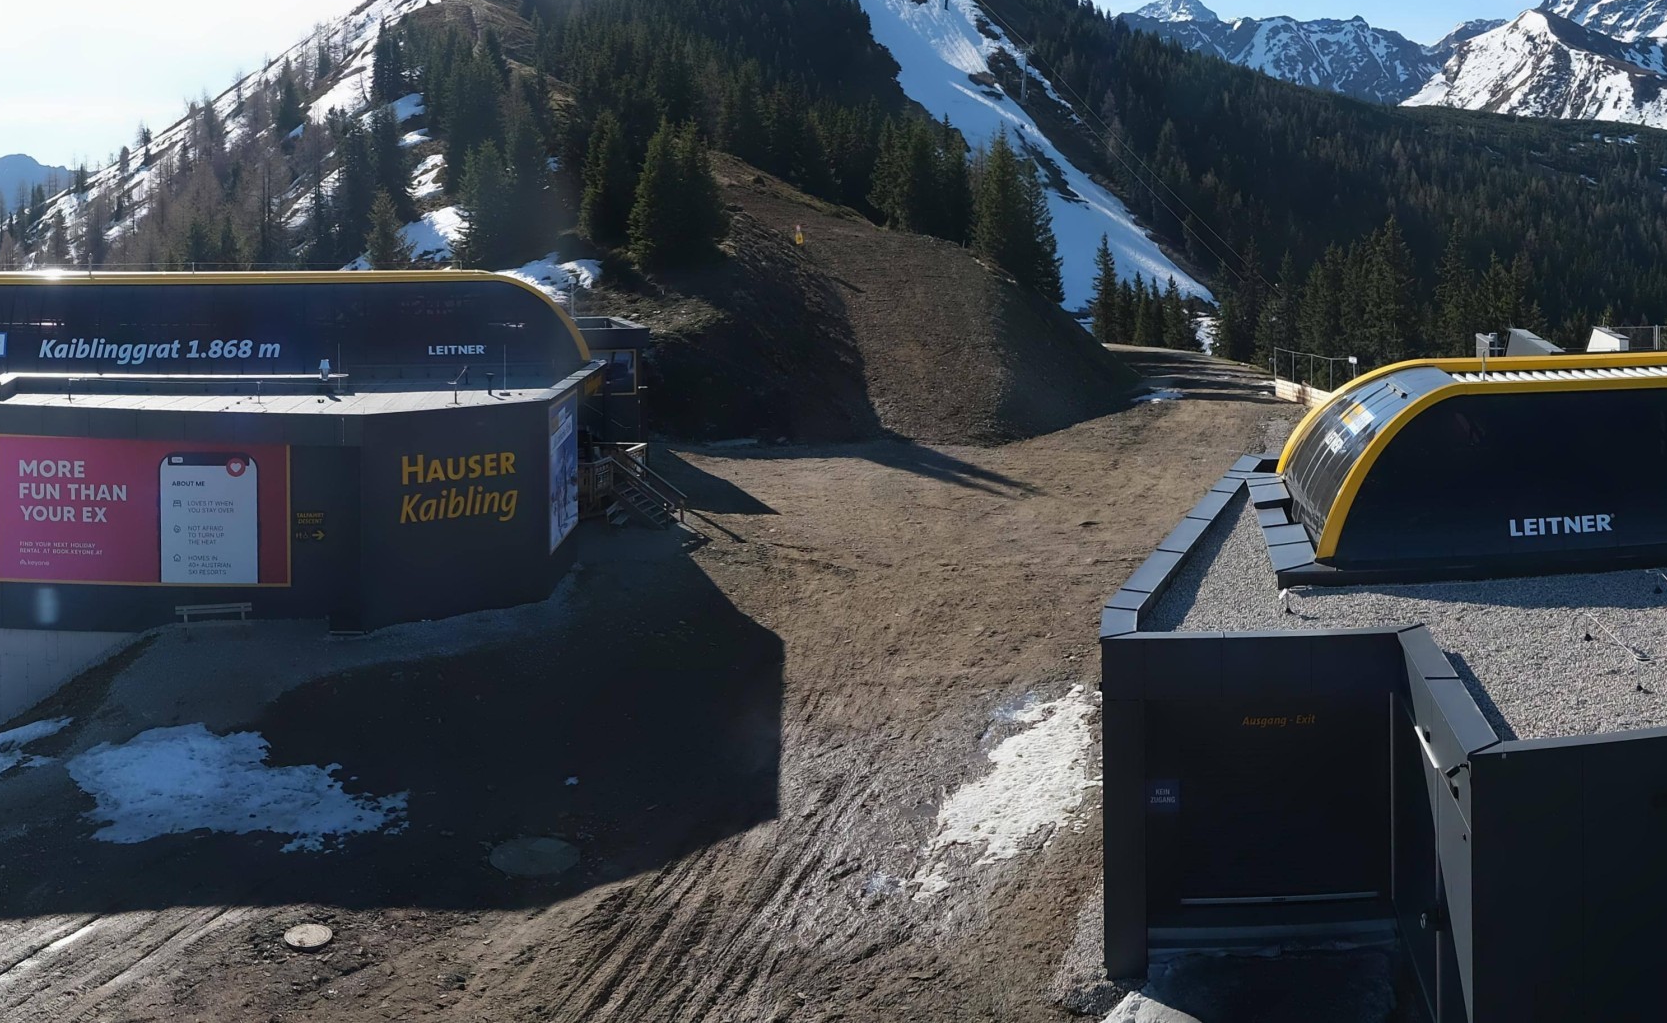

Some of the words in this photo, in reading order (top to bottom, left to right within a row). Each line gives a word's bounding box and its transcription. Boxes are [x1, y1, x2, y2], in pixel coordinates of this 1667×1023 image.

[38, 338, 181, 365] Kaiblinggrat
[185, 339, 252, 358] 1.868
[258, 343, 281, 358] m
[428, 345, 485, 355] LEITNER
[18, 459, 86, 478] MORE
[401, 452, 516, 485] HAUSER
[19, 482, 60, 500] FUN
[67, 483, 127, 501] THAN
[400, 485, 519, 524] Kaibling
[20, 505, 76, 522] YOUR
[82, 506, 108, 523] EX
[1509, 514, 1613, 537] LEITNER
[27, 559, 50, 567] keyone
[1242, 715, 1288, 728] Ausgang
[1295, 714, 1316, 725] Exit
[1150, 795, 1176, 804] ZUGANG
[1155, 788, 1171, 796] KEIN
